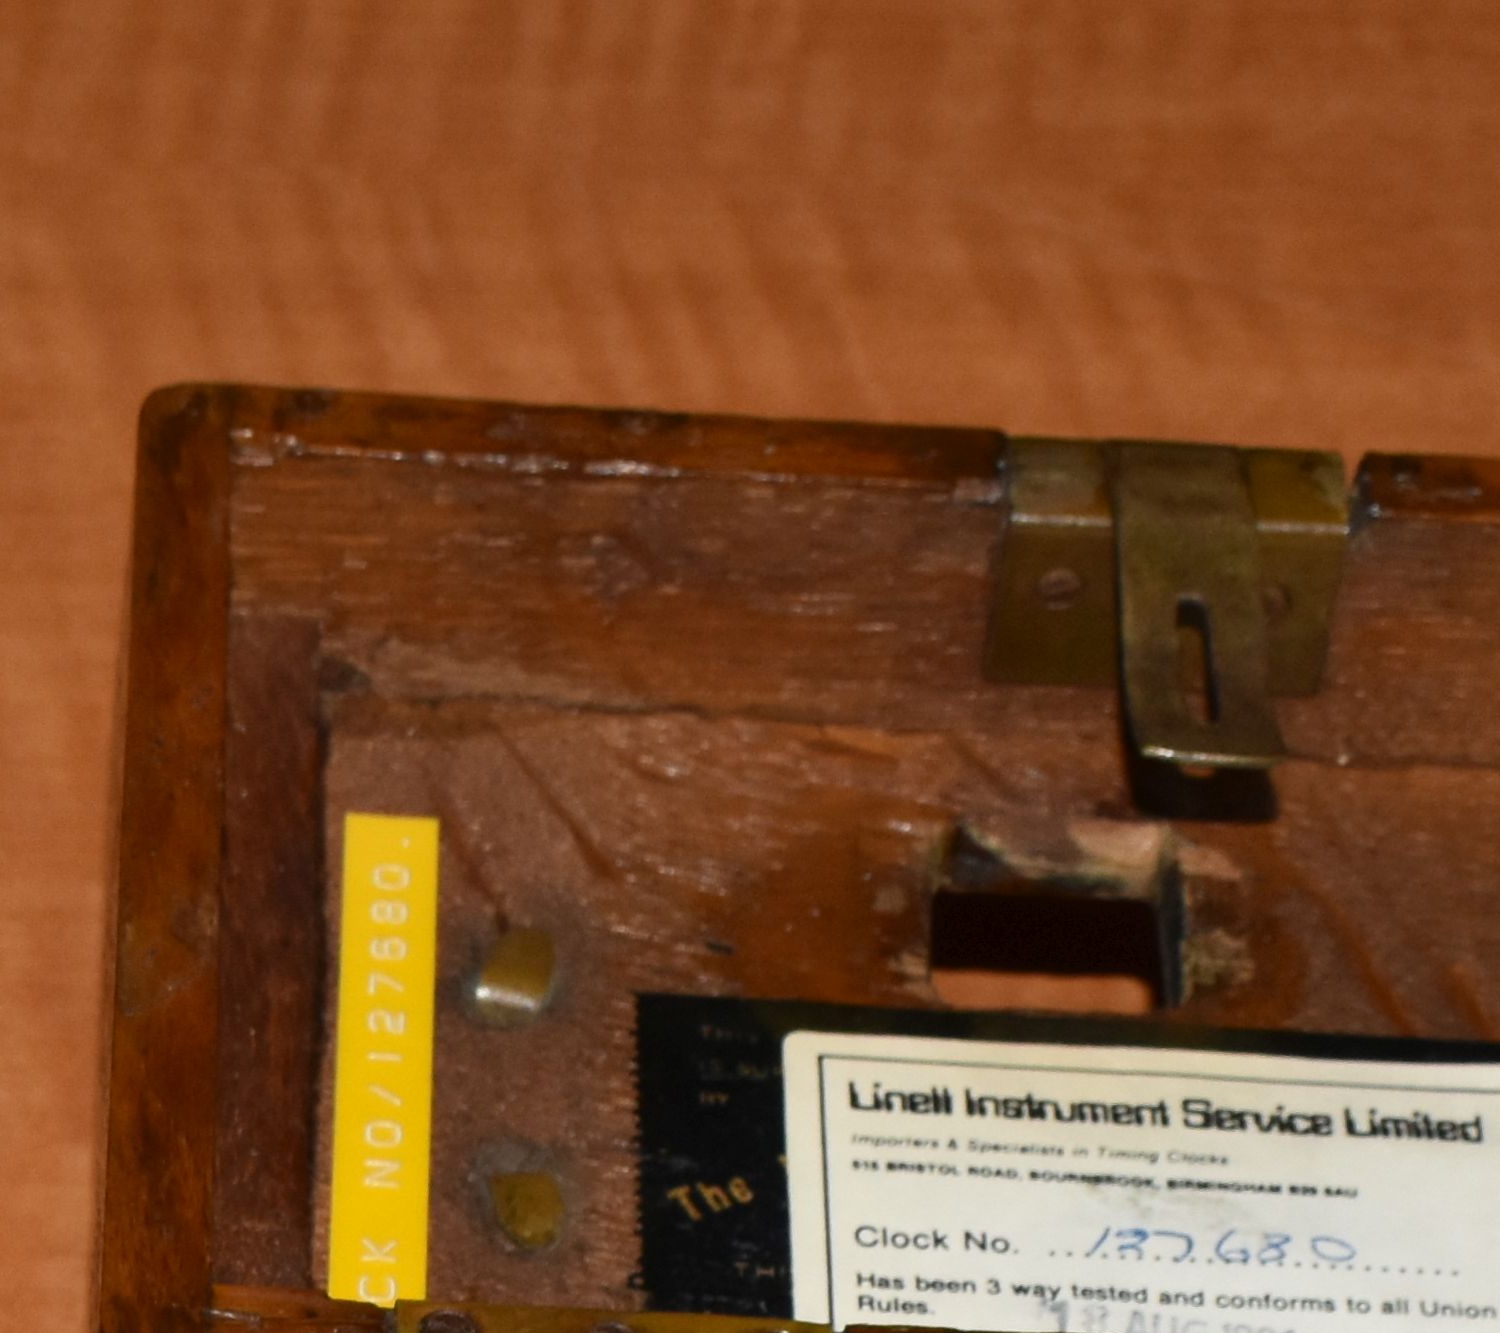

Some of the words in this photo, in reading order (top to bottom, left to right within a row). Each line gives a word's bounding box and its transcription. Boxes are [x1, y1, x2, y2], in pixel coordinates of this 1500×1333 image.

[848, 1080, 954, 1117] Linell
[964, 1087, 1171, 1129] Instrument
[1180, 1097, 1333, 1137] Service
[1343, 1106, 1485, 1144] Limited
[850, 1132, 941, 1152] Importers
[967, 1138, 1066, 1158] Specialists
[1071, 1145, 1090, 1157] in
[1096, 1146, 1161, 1165] Timing
[1166, 1151, 1231, 1166] Clocks
[885, 1160, 959, 1177] BRISTOL
[1165, 1177, 1284, 1196] BIRMINGHAM
[667, 1176, 755, 1223] The
[853, 1225, 950, 1252] Clock
[963, 1230, 1020, 1256] No.
[856, 1272, 906, 1292] Has
[914, 1275, 977, 1296] been
[986, 1278, 1003, 1297] 3
[1010, 1284, 1062, 1305] way
[1071, 1282, 1149, 1306] tested
[1158, 1288, 1206, 1308] and
[1214, 1291, 1337, 1315] conforms
[1345, 1297, 1373, 1315] to
[1381, 1297, 1412, 1317] all
[1419, 1300, 1500, 1321] Union
[857, 1294, 937, 1317] Rules.
